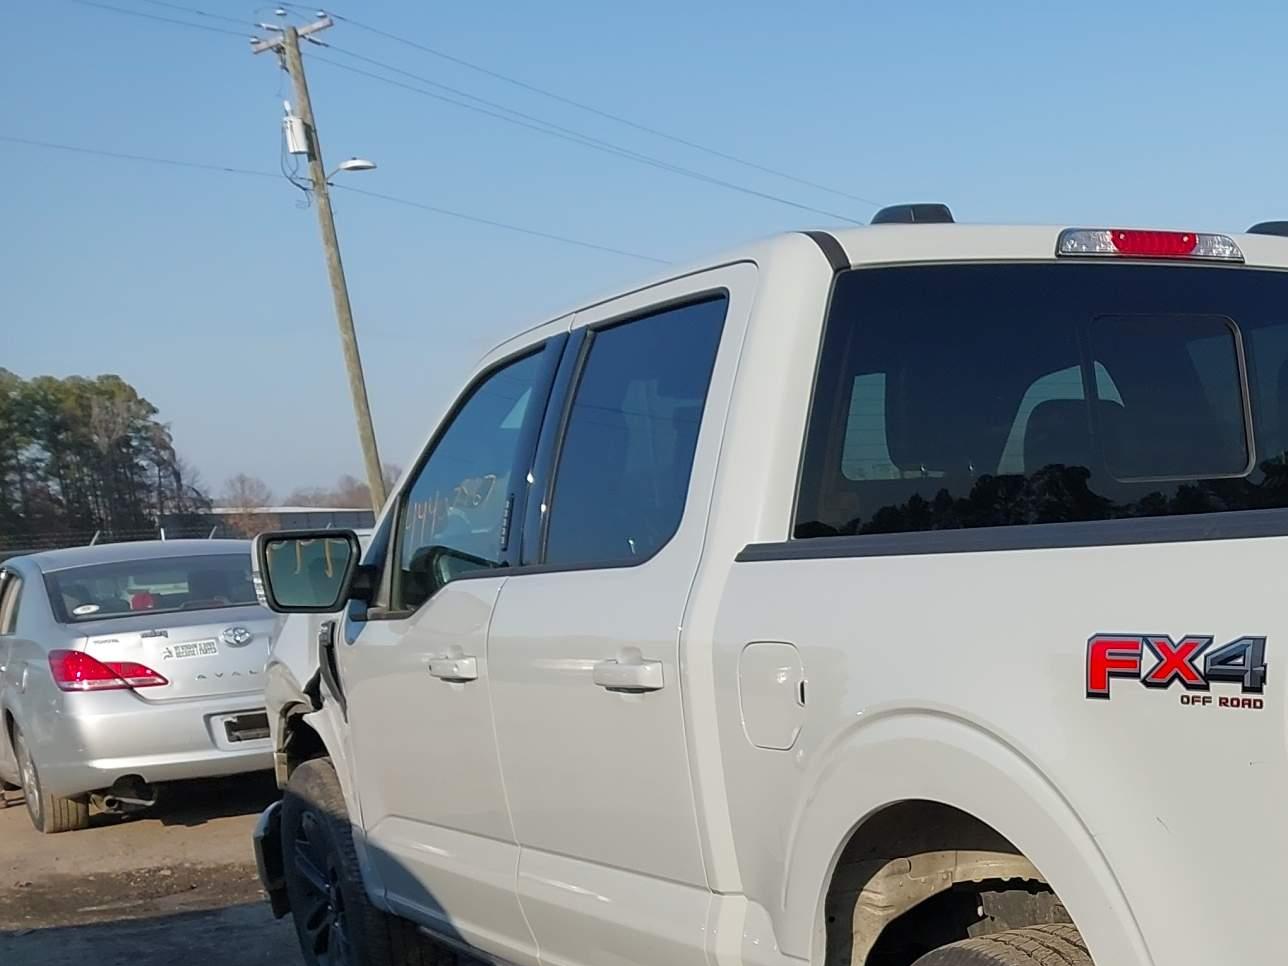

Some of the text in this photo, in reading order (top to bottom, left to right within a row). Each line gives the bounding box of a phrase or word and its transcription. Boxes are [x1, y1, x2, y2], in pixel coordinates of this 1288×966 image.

[1086, 633, 1267, 699] FX4
[1180, 695, 1264, 709] OFF ROAD
